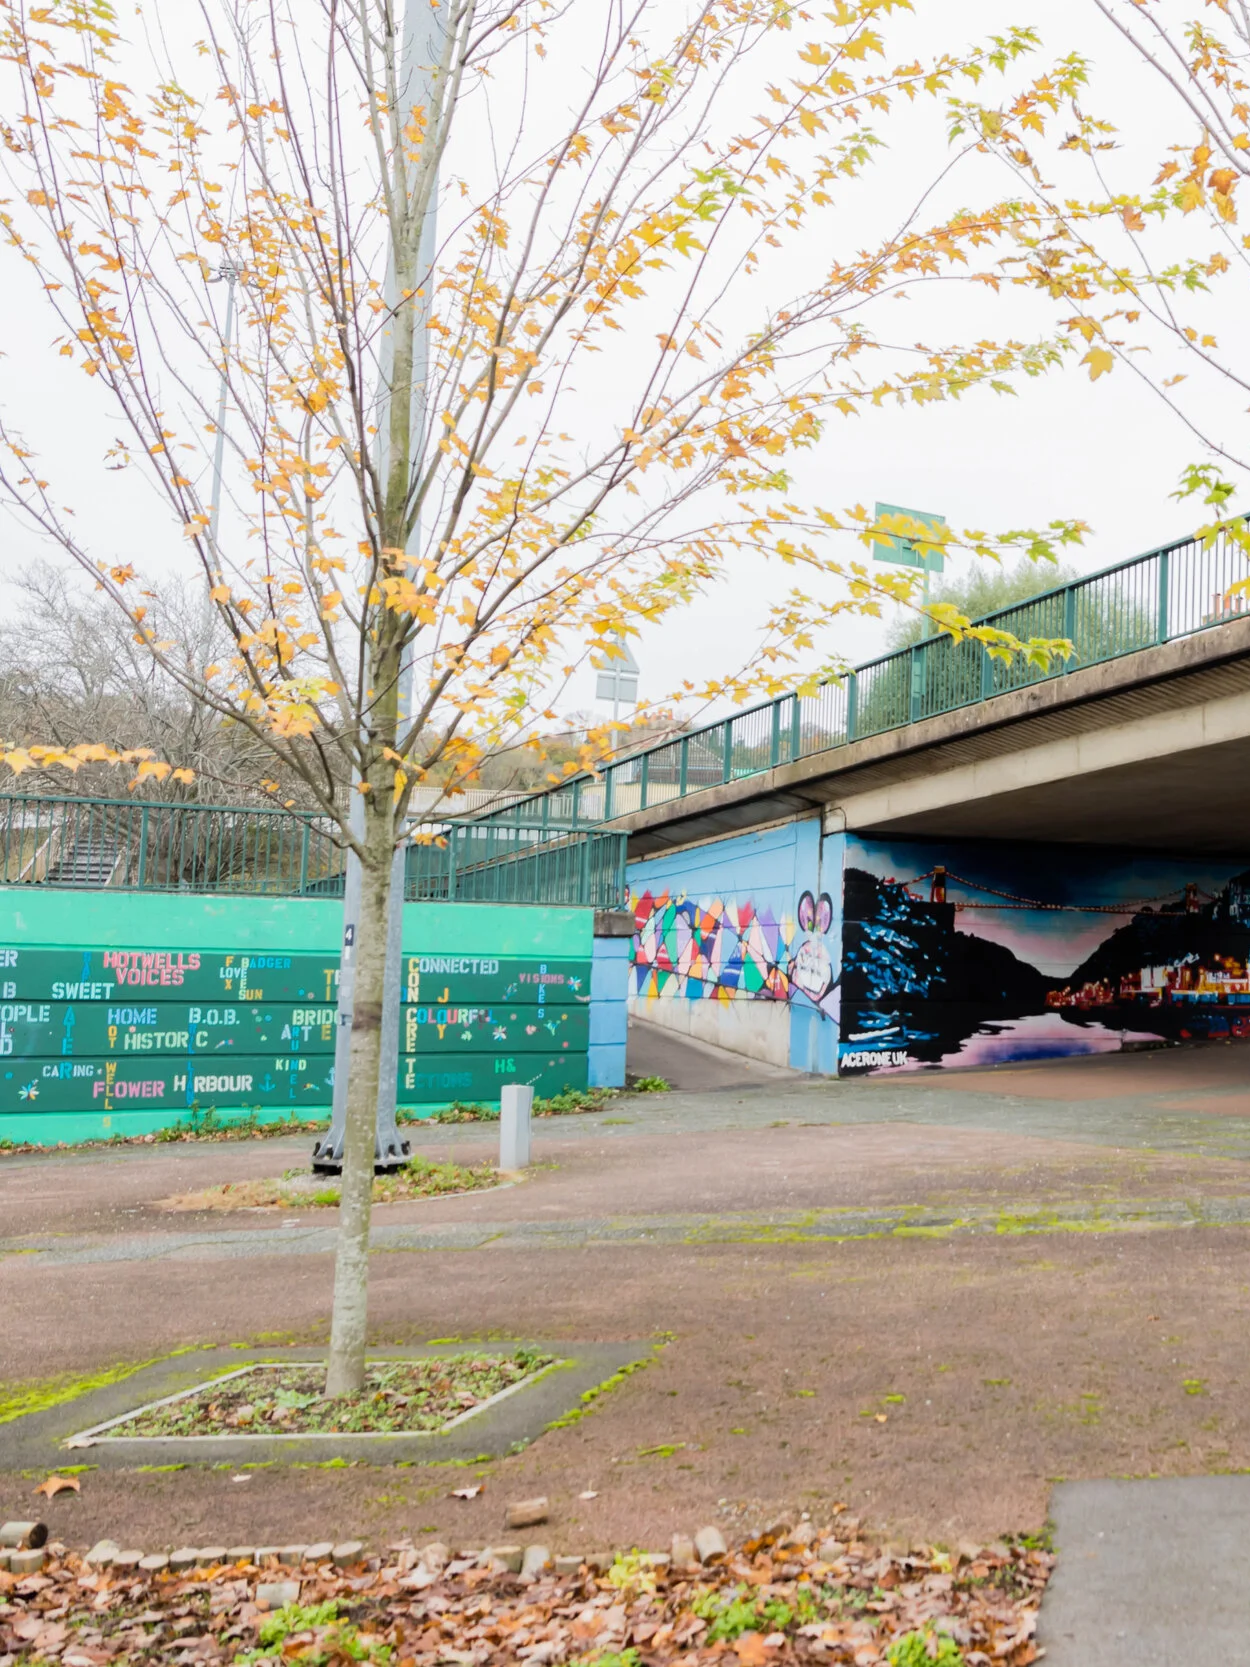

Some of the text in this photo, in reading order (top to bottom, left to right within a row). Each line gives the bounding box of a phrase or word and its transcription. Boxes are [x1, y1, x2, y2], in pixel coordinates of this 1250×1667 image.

[103, 951, 200, 970] HOTWELLS
[241, 957, 291, 969] BADGER
[408, 957, 499, 975] CONNECTED
[116, 968, 185, 986] VOICES
[219, 966, 247, 979] LOVE
[519, 974, 565, 985] VISIONS
[51, 981, 115, 1000] SWEET
[107, 1008, 157, 1025] HOME
[188, 1007, 240, 1025] B.O.B.
[406, 1008, 498, 1024] COLOURFUL
[124, 1031, 208, 1050] HISTORIC
[42, 1062, 94, 1080] CARING
[275, 1059, 307, 1072] KIND
[93, 1080, 165, 1099] FLOWER
[173, 1074, 253, 1093] HARBOUR
